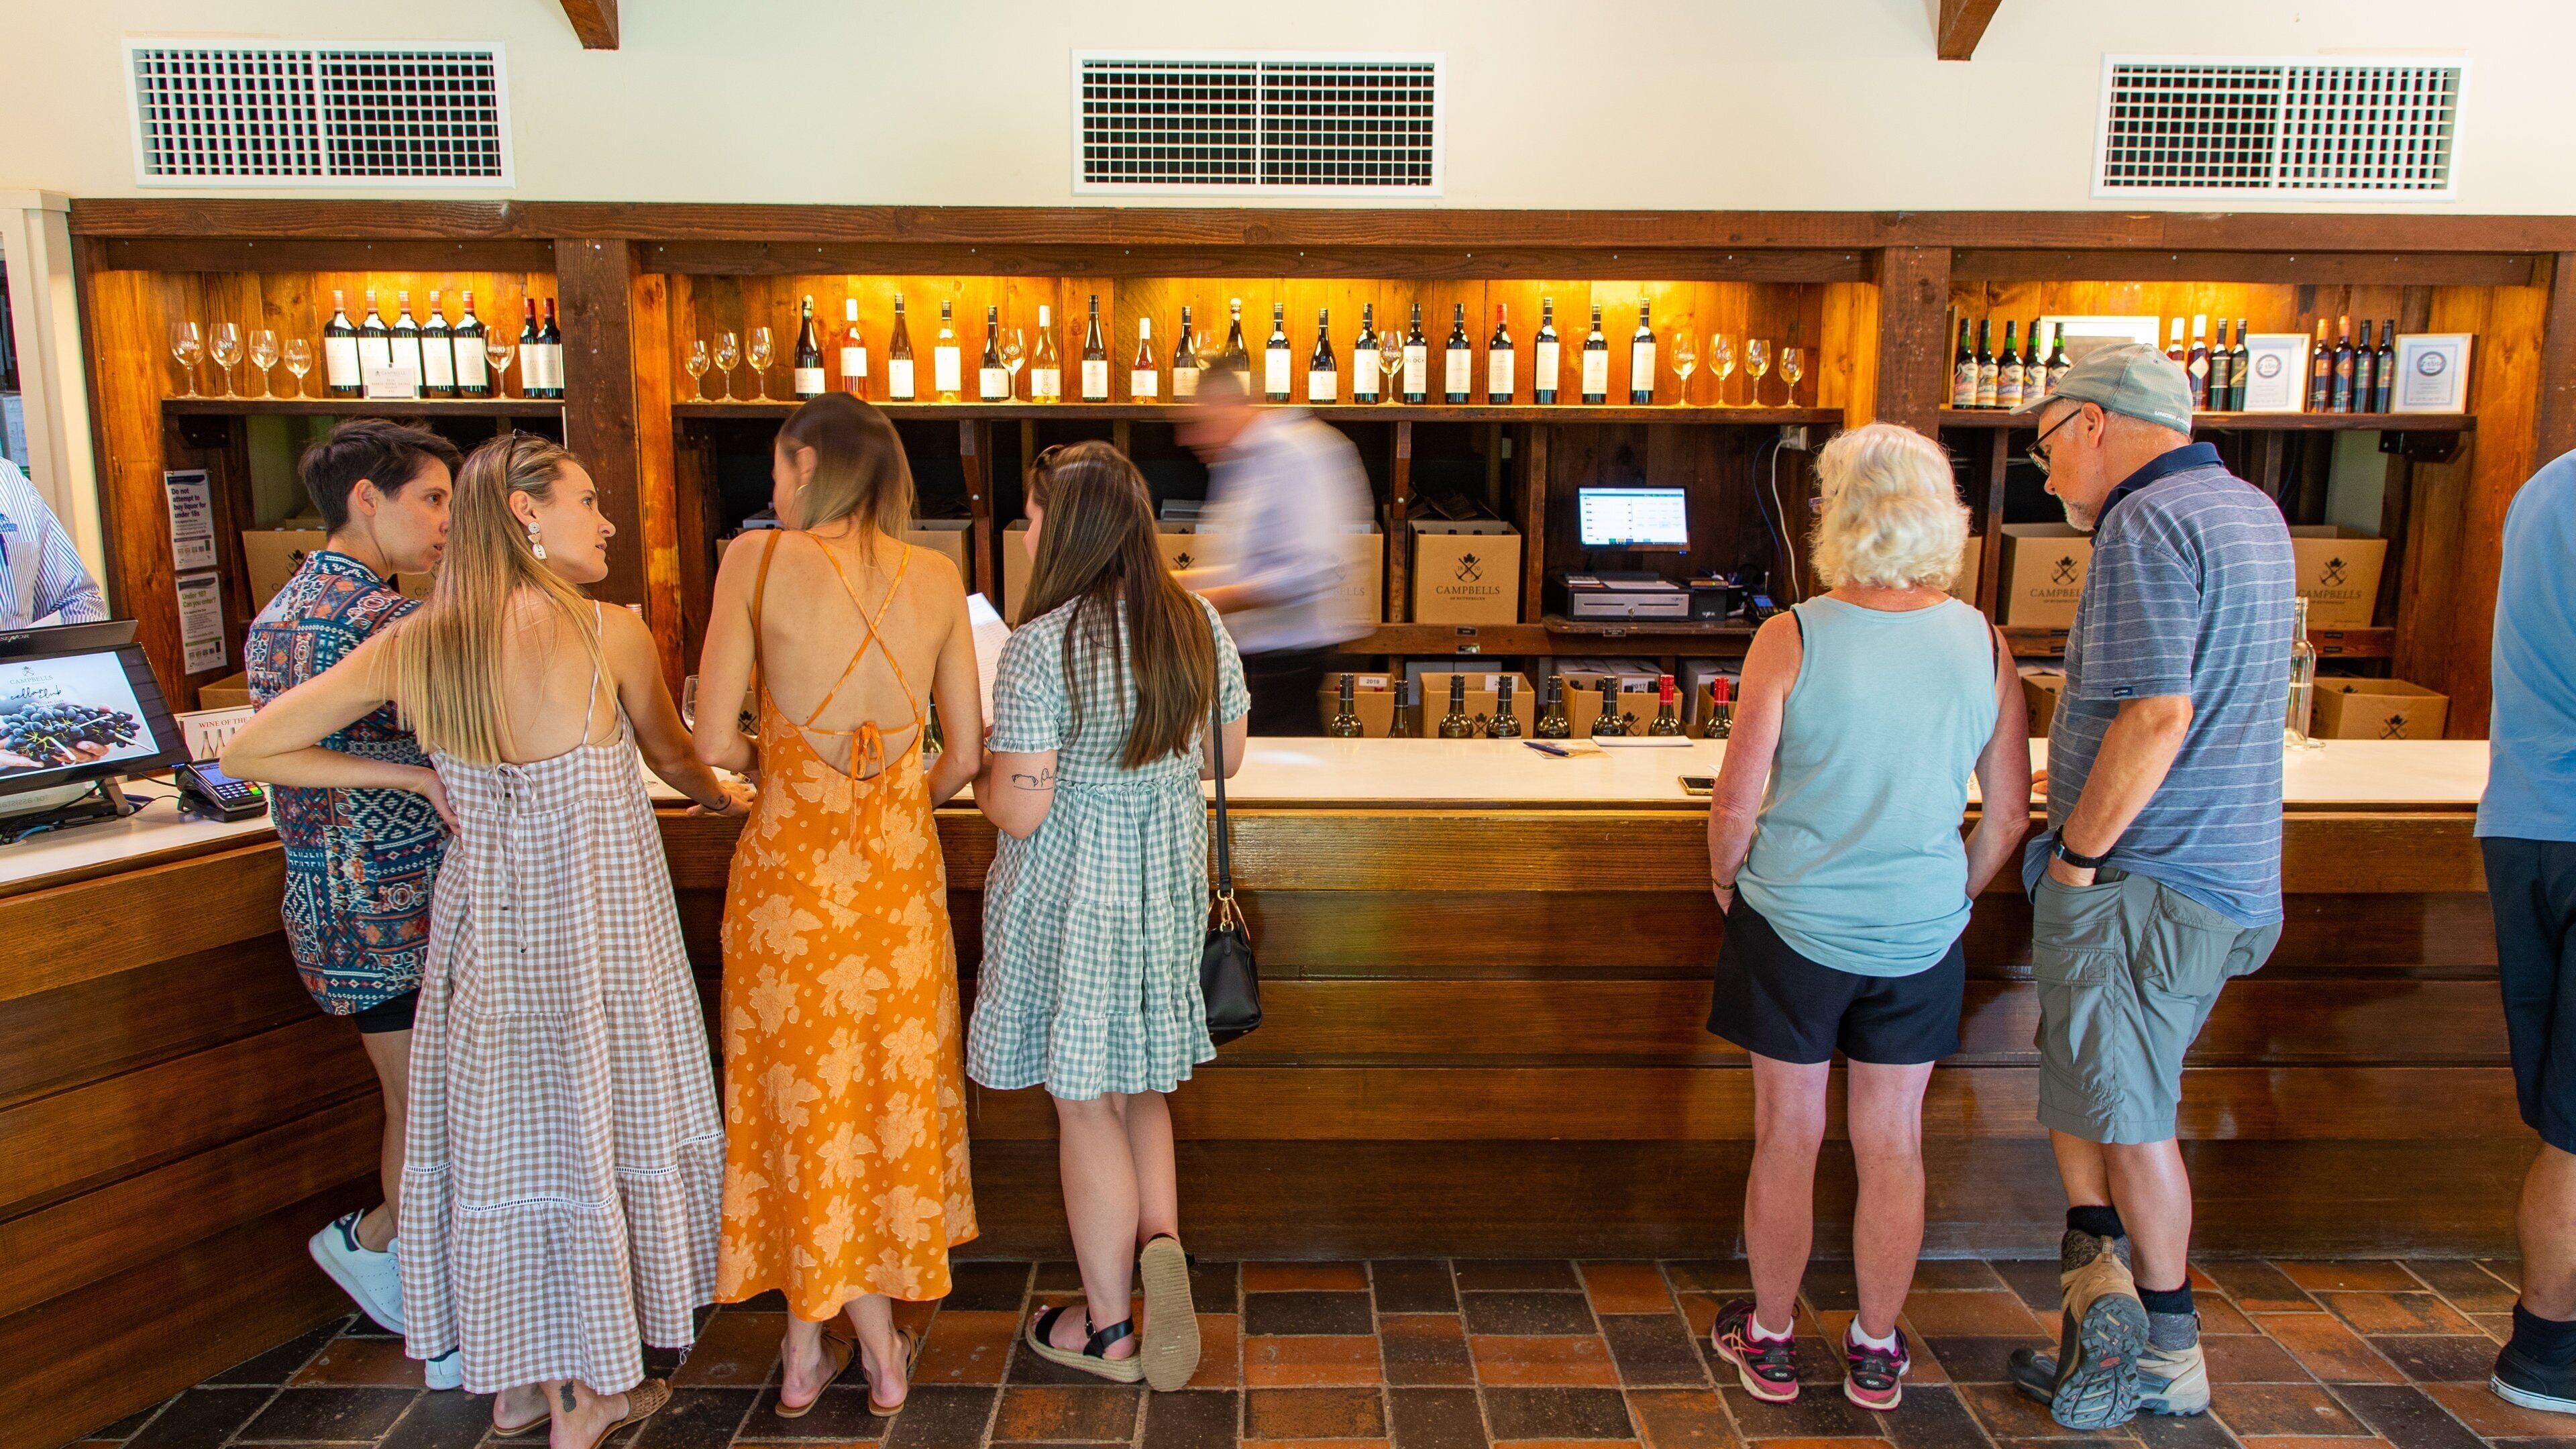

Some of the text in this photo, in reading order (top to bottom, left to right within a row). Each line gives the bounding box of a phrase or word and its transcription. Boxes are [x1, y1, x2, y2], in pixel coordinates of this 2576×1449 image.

[173, 504, 183, 512] buy
[1436, 586, 1501, 594] CAMPBELLS
[2030, 588, 2080, 598] CAMPBEL
[2298, 590, 2361, 599] CAMPBELLS
[182, 592, 197, 600] Under
[9, 675, 53, 685] CAMPBELLS
[199, 720, 220, 729] WINE
